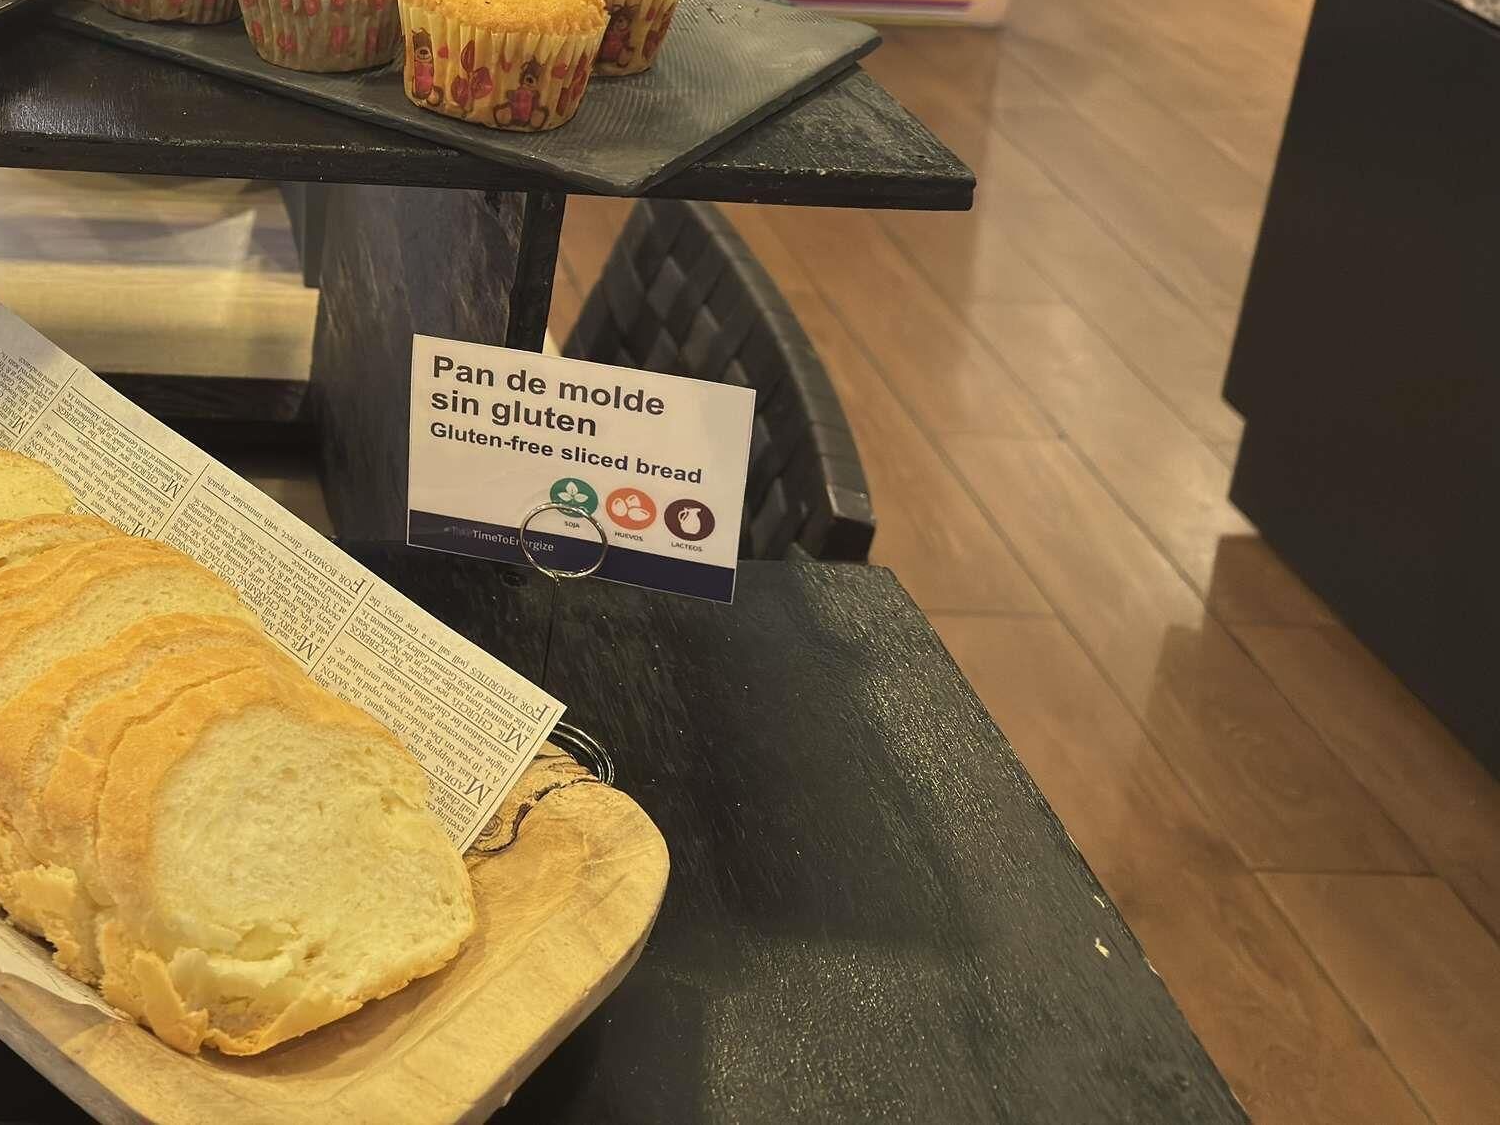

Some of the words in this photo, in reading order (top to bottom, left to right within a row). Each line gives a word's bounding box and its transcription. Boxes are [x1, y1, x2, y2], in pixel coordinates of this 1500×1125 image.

[433, 355, 494, 387] Pan
[506, 370, 546, 395] de
[558, 381, 665, 415] molde
[431, 390, 479, 416] sin
[491, 400, 596, 437] gluten
[430, 422, 553, 457] Gluten-free
[561, 446, 628, 471] sliced
[637, 458, 701, 484] bread
[614, 531, 644, 542] HUEVOS
